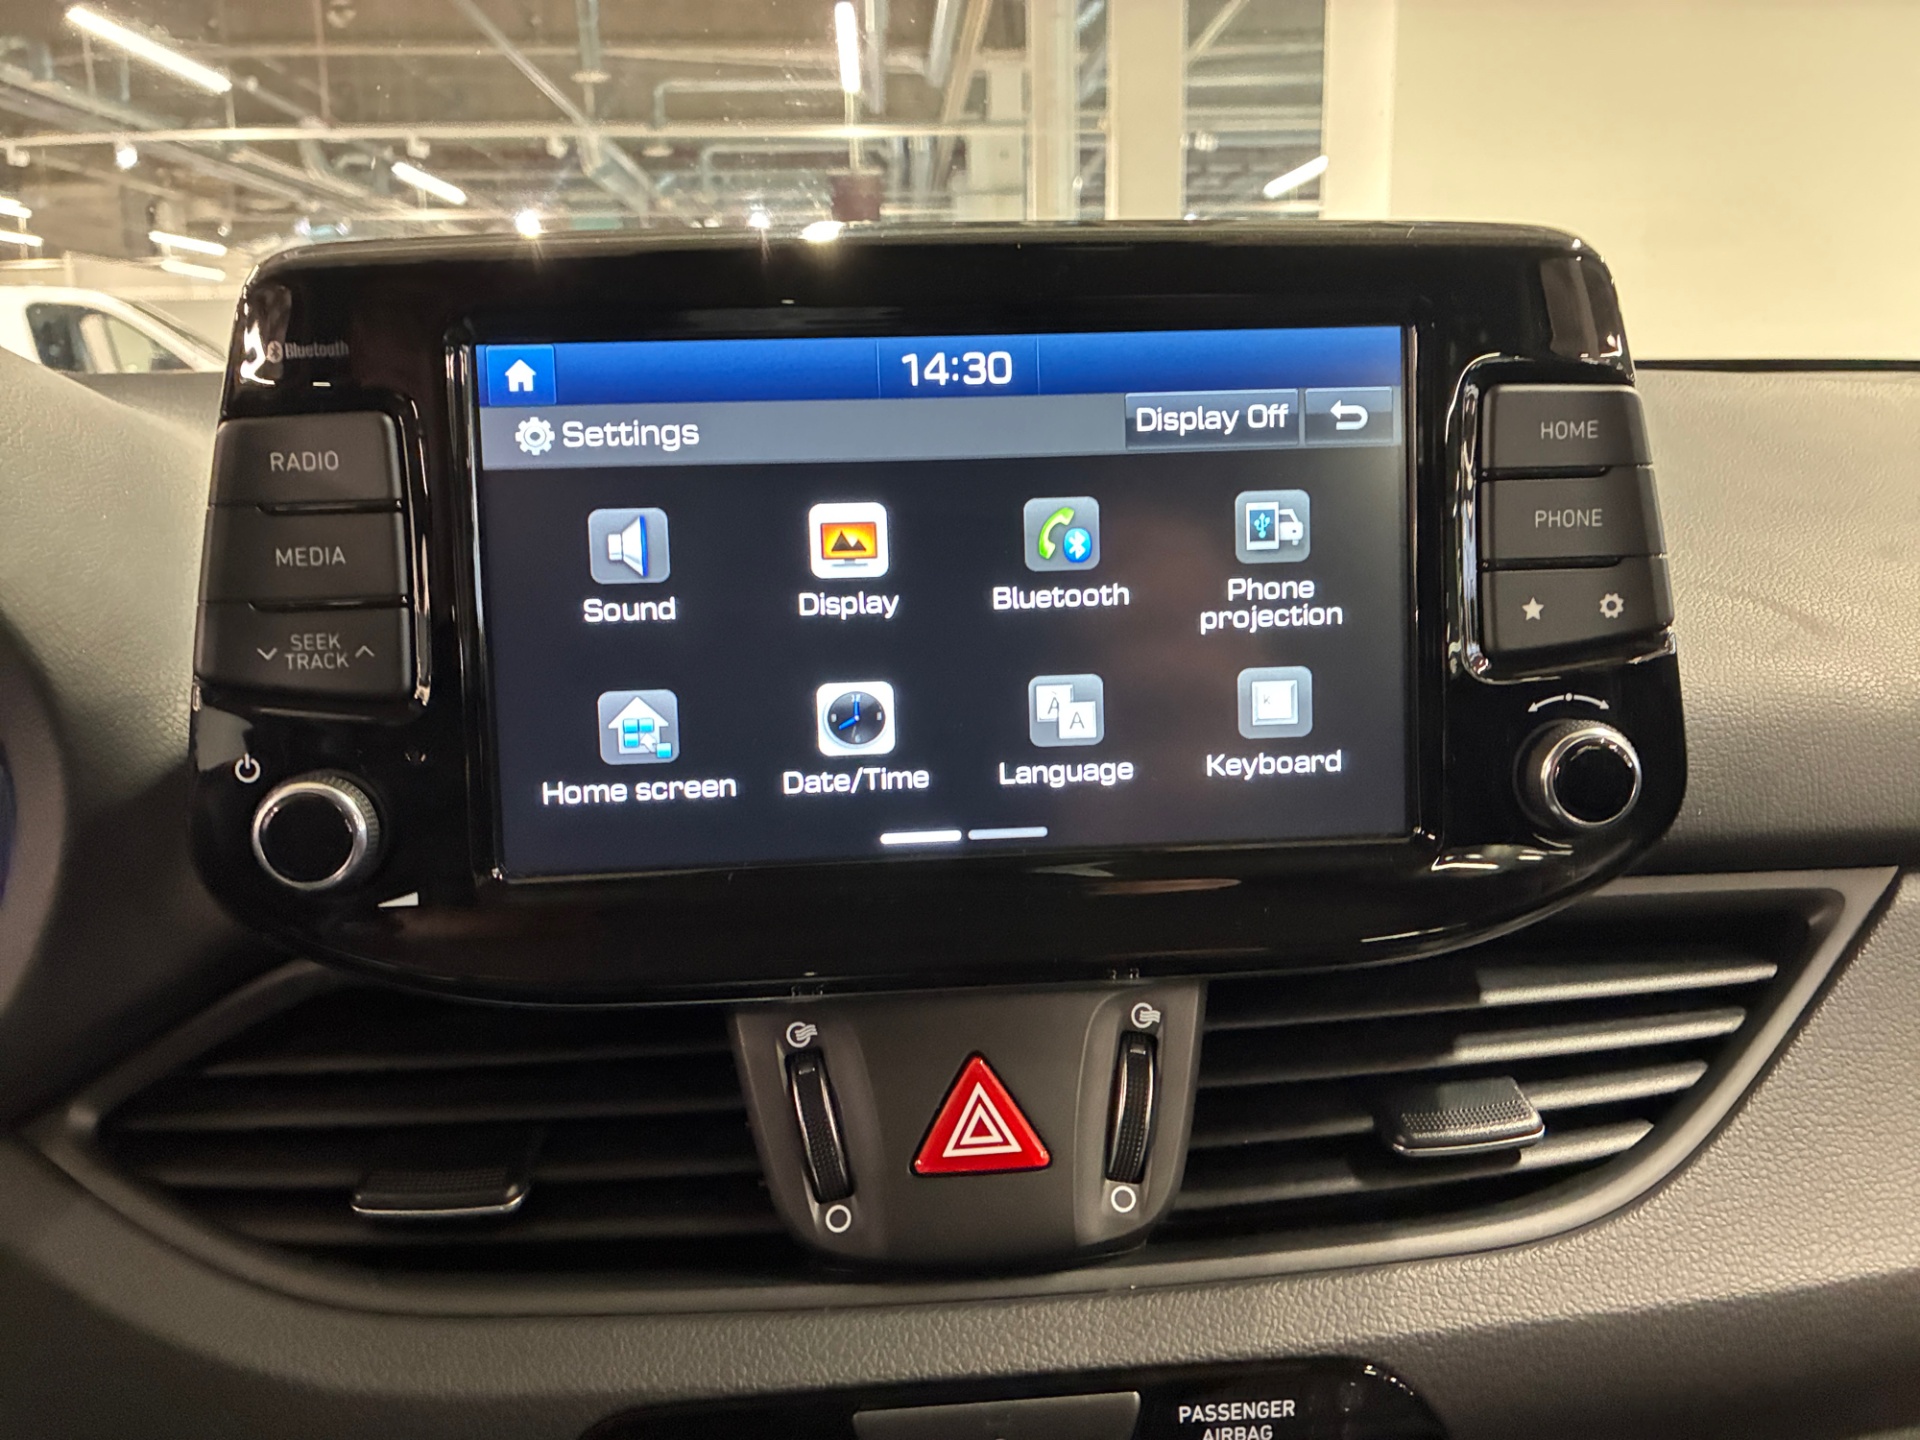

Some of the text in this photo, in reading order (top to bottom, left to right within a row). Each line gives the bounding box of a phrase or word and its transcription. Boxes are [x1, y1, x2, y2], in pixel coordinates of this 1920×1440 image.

[284, 340, 350, 359] Bluetooth
[901, 350, 1013, 387] 14:30
[1136, 403, 1290, 435] Display Off
[1540, 420, 1599, 440] HOME
[561, 420, 700, 451] Settings
[269, 450, 340, 472] RADIO
[1534, 509, 1603, 529] PHONE
[275, 546, 347, 567] MEDIA
[992, 582, 1130, 610] Bluetooth
[1227, 577, 1315, 601] Phone
[583, 596, 677, 623] Sound
[798, 591, 900, 620] Display
[1200, 604, 1343, 634] projection
[290, 633, 341, 650] SEEK
[285, 653, 349, 670] TRACK
[999, 759, 1134, 787] Language
[1206, 749, 1342, 780] Keyboard
[542, 777, 737, 805] Home screen
[783, 767, 930, 796] Date/Time
[1178, 1400, 1295, 1424] PASSENGER
[1202, 1424, 1273, 1440] AIRBAG
